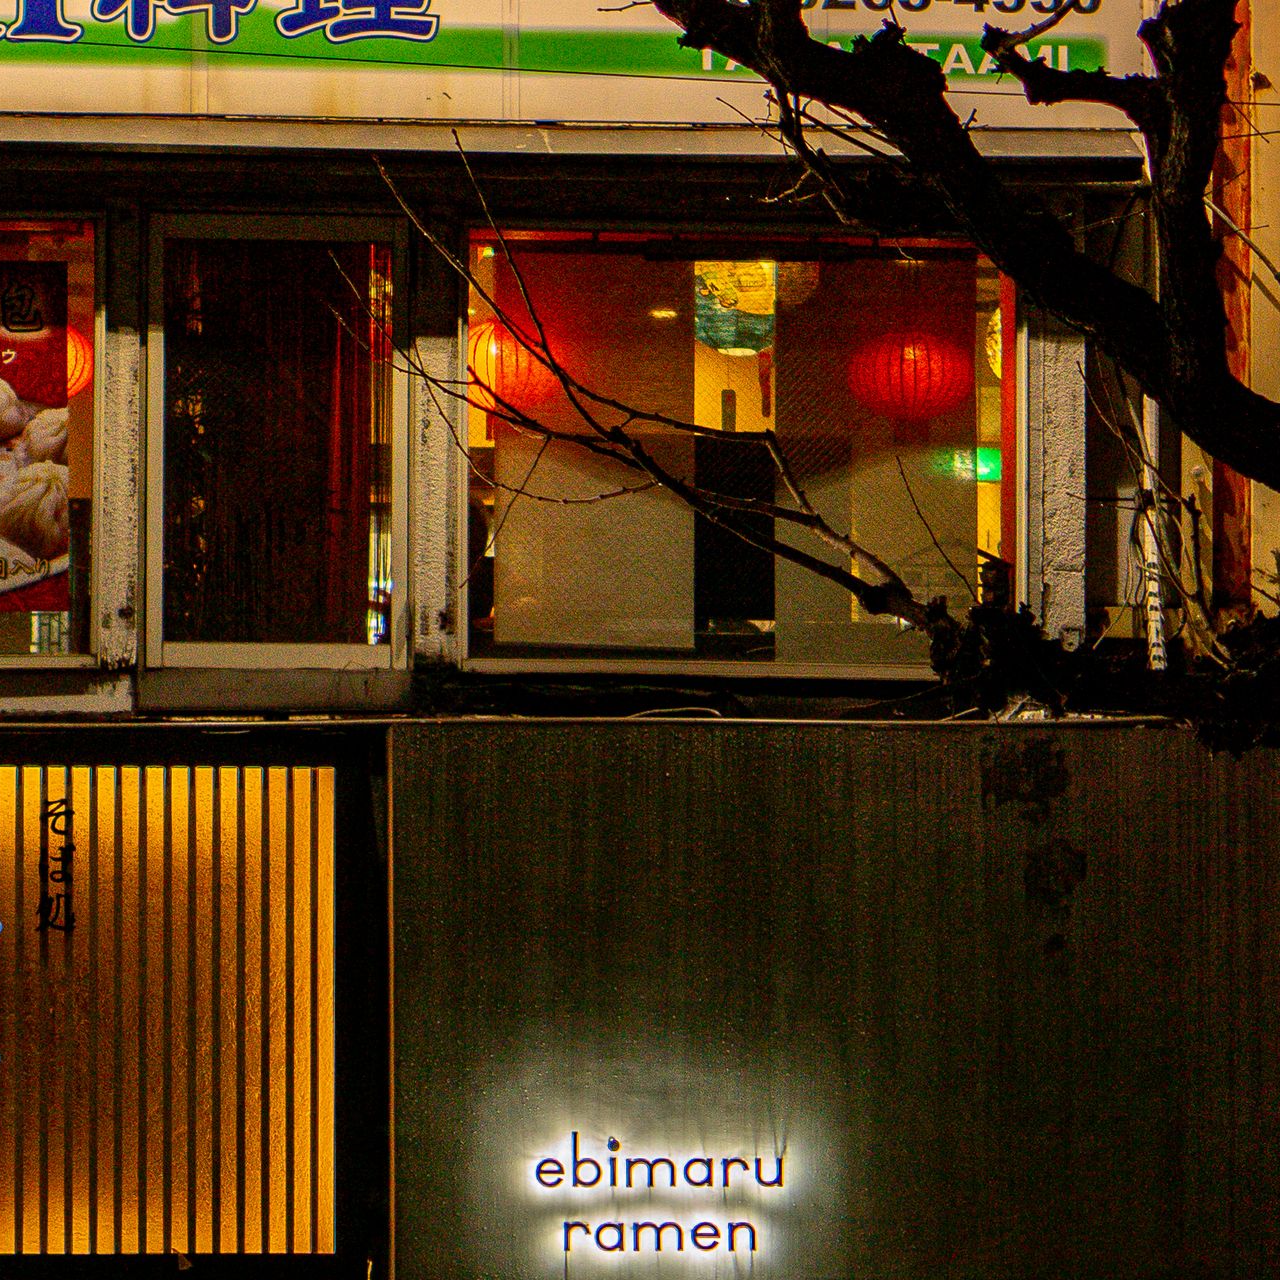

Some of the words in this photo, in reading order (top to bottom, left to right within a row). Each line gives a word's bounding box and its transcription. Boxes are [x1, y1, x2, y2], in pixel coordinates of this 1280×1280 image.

[36, 797, 77, 936] そば処
[534, 1130, 785, 1189] ebimaru
[563, 1220, 757, 1253] ramen
